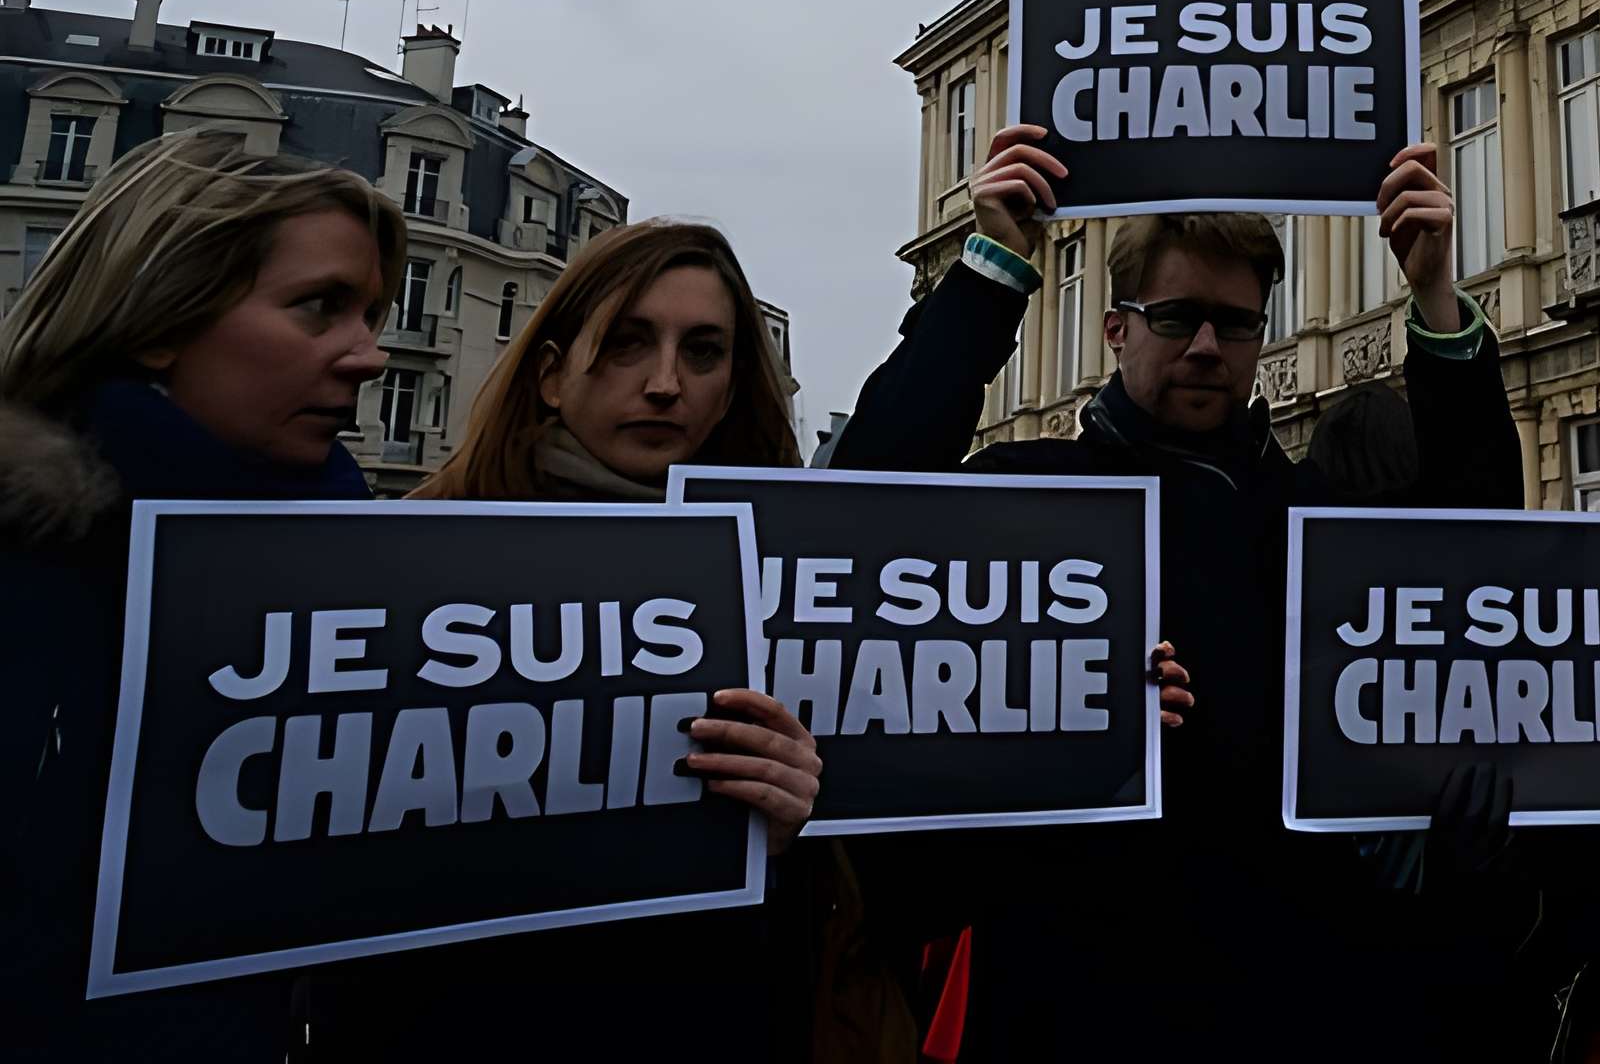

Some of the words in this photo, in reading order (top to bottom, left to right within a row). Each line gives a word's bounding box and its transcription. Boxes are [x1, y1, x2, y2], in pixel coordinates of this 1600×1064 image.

[1054, 4, 1158, 60] JE
[1177, 1, 1373, 55] SUIS
[1051, 63, 1376, 142] CHARLIE
[875, 557, 1109, 626] SUIS
[1335, 586, 1445, 647] JE
[207, 607, 389, 701] JE
[416, 598, 704, 688] SUIS
[765, 638, 1110, 736] HARLIE
[195, 691, 708, 846] CHARLIE
